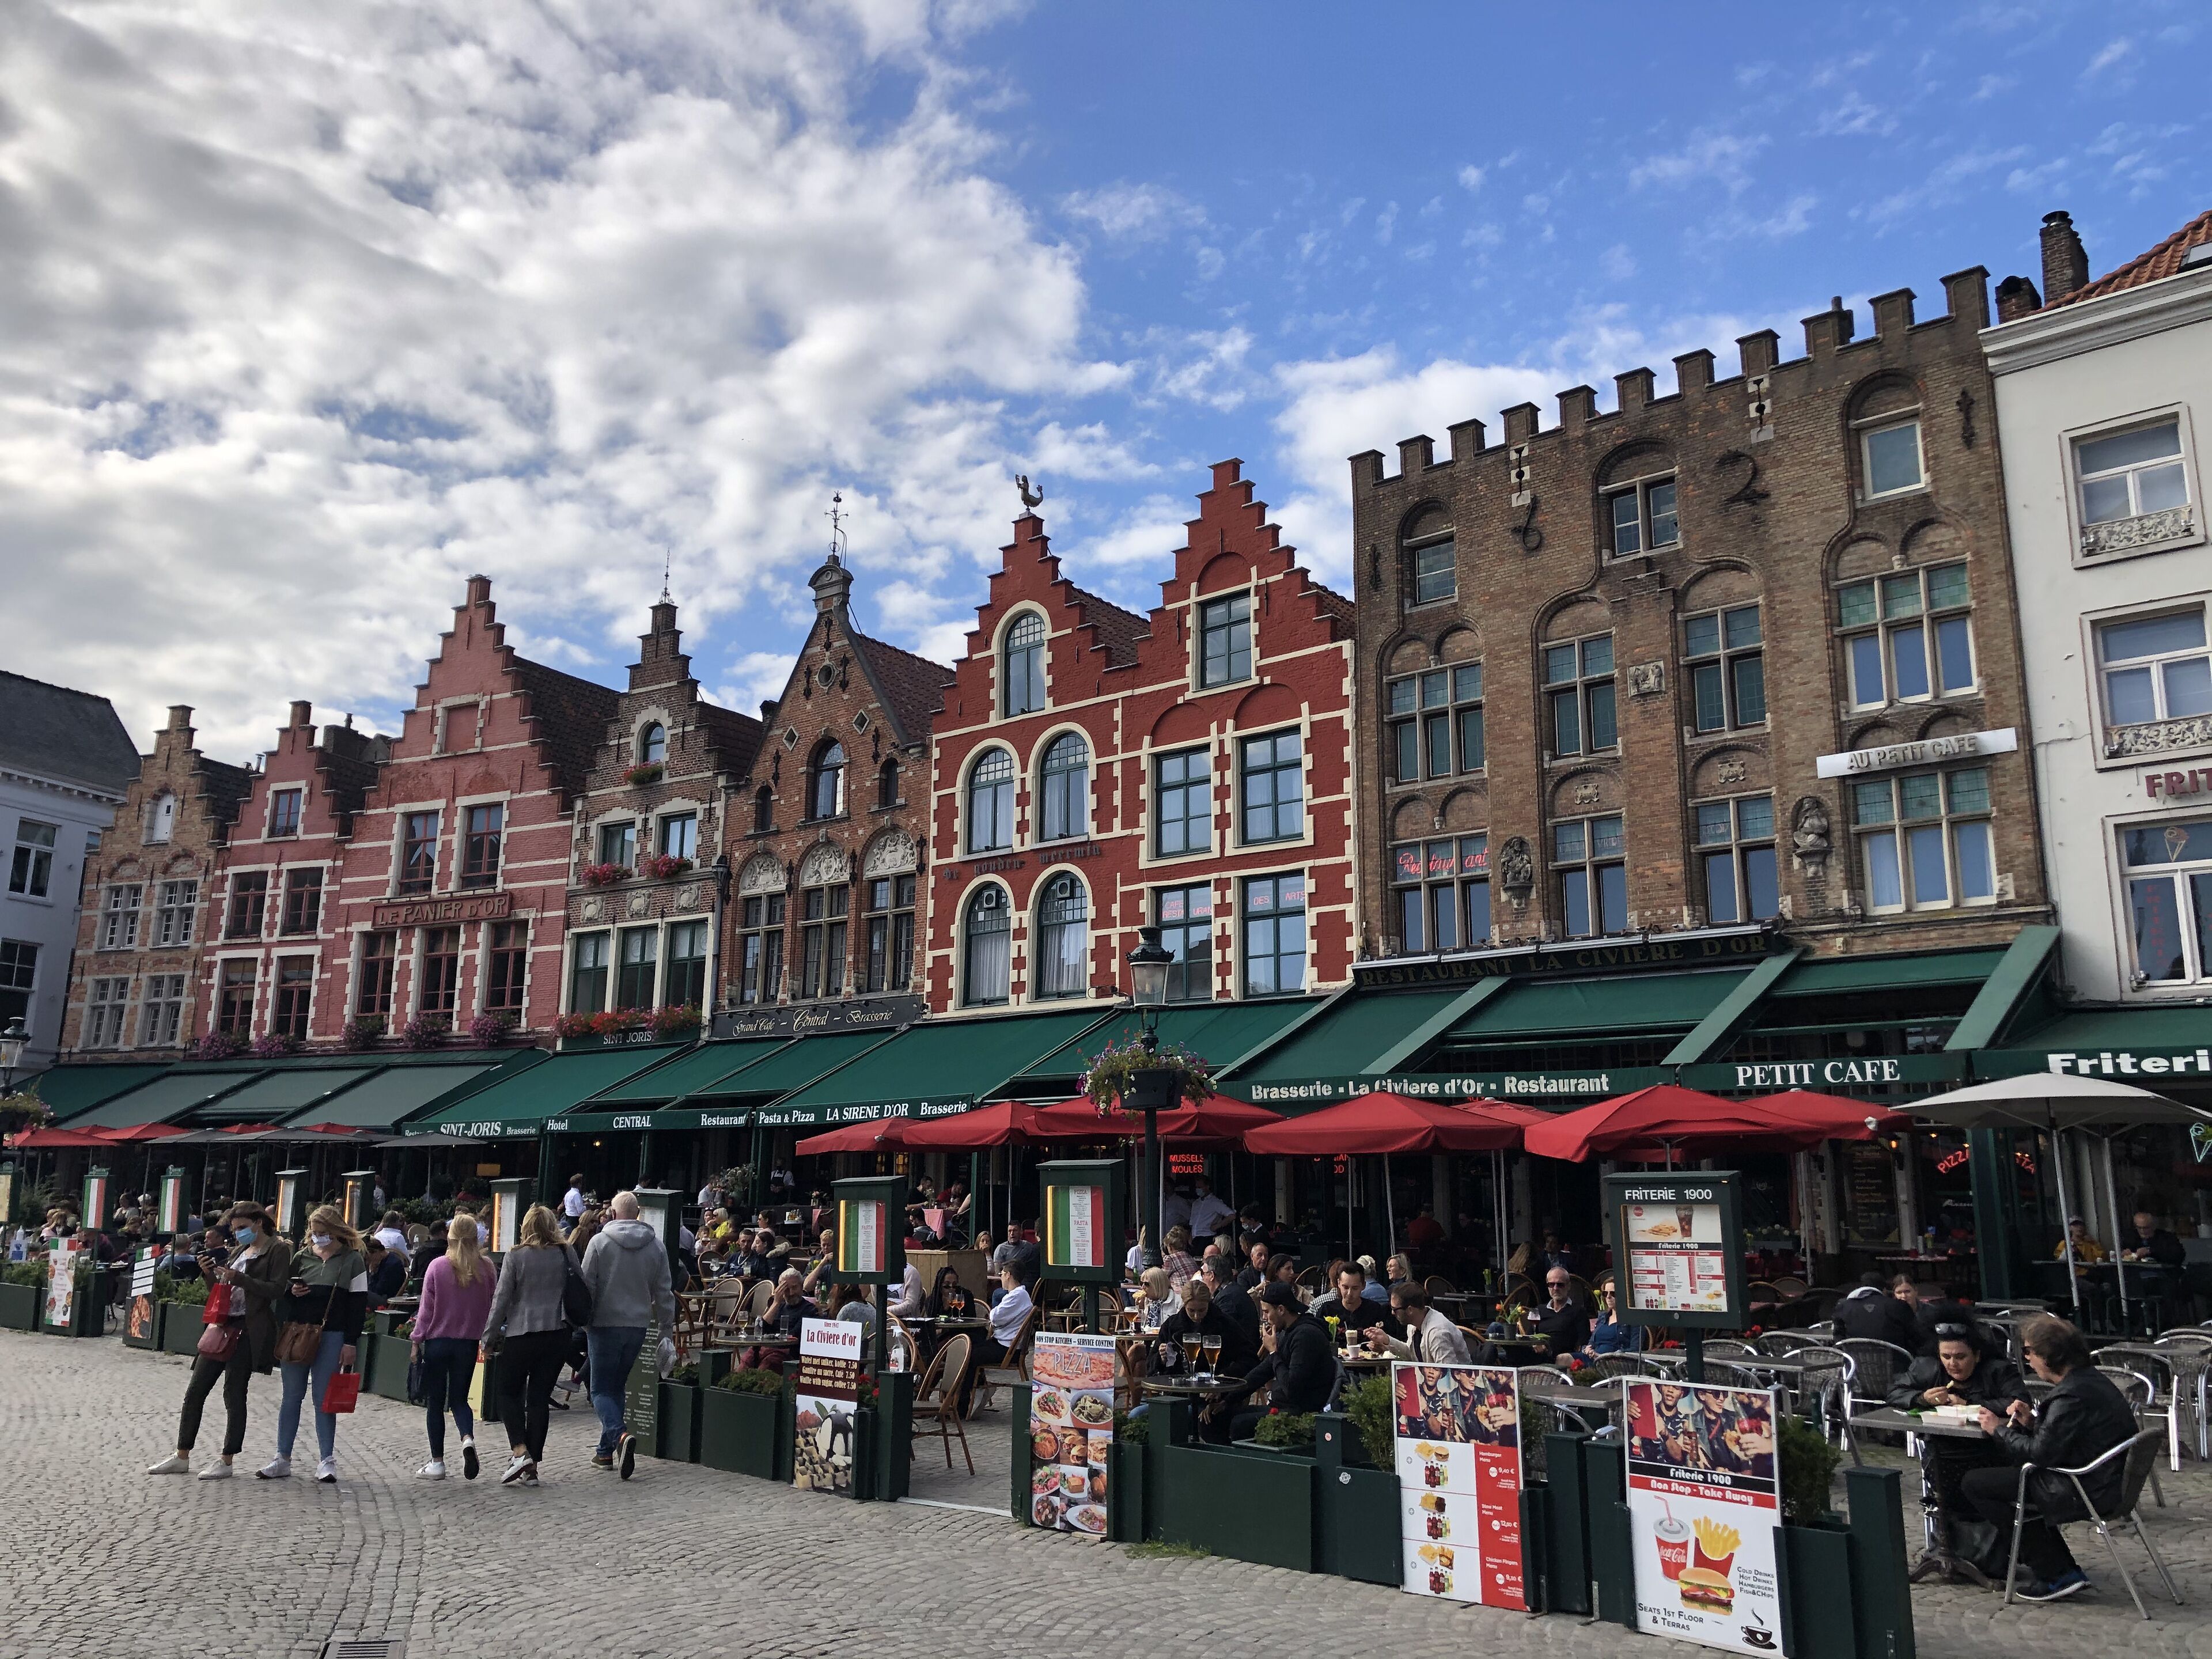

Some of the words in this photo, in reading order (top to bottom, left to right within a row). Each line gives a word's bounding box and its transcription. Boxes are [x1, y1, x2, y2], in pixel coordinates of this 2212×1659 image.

[1847, 752, 1871, 770] AU
[1876, 743, 1925, 766] PETIT
[1931, 735, 1978, 757] CAFE
[1253, 895, 1270, 906] DES
[378, 911, 399, 926] LE
[404, 902, 463, 922] PANIER
[467, 897, 506, 918] D'OR
[1360, 959, 1514, 986] RESTAURANT
[1528, 950, 1563, 972] LA
[1576, 942, 1685, 967] CIVIERE
[1702, 934, 1767, 955] D'OR
[732, 1020, 759, 1036] Grand
[793, 1009, 829, 1032] Central
[846, 1009, 893, 1025] Brasserie
[603, 1033, 623, 1045] SINT
[626, 1032, 652, 1043] JORIS
[1735, 1063, 1815, 1086] PETIT
[1824, 1059, 1900, 1083] CAFE
[1251, 1081, 1332, 1100] Brasserie
[1349, 1081, 1370, 1096] La
[1374, 1078, 1440, 1094] Civiere
[1444, 1077, 1484, 1094] d'Or
[1505, 1073, 1609, 1094] Restaurant
[759, 1111, 782, 1124] Pasta
[784, 1113, 789, 1123] &
[792, 1109, 815, 1123] Pizza
[825, 1107, 839, 1121] LA
[842, 1104, 880, 1120] SIRENE
[883, 1103, 909, 1118] D'OR
[920, 1100, 967, 1115] Brasserie
[440, 1122, 501, 1137] SINT-JORIS
[506, 1126, 536, 1136] Brasserie
[546, 1119, 568, 1131] Hotel
[613, 1115, 652, 1129] CENTRAL
[700, 1112, 748, 1126] Restaurant
[1169, 1154, 1204, 1162] MUSSELS
[1172, 1164, 1203, 1173] MOULES
[1684, 1189, 1712, 1200] 1900
[806, 1330, 815, 1343] La
[817, 1330, 840, 1345] Civiere
[842, 1332, 857, 1347] d'or
[1044, 1336, 1055, 1344] STOP
[1055, 1336, 1073, 1345] KITCHEN
[1077, 1338, 1094, 1346] SERVICE
[1095, 1339, 1114, 1348] CONTINU
[1054, 1351, 1092, 1374] PIZZA
[1669, 1468, 1705, 1481] Friterie
[1707, 1472, 1732, 1486] 1900
[1650, 1479, 1669, 1491] Non
[1671, 1482, 1691, 1496] Stop
[1698, 1486, 1723, 1499] Take
[1725, 1490, 1753, 1506] Away
[1652, 1616, 1658, 1624] &
